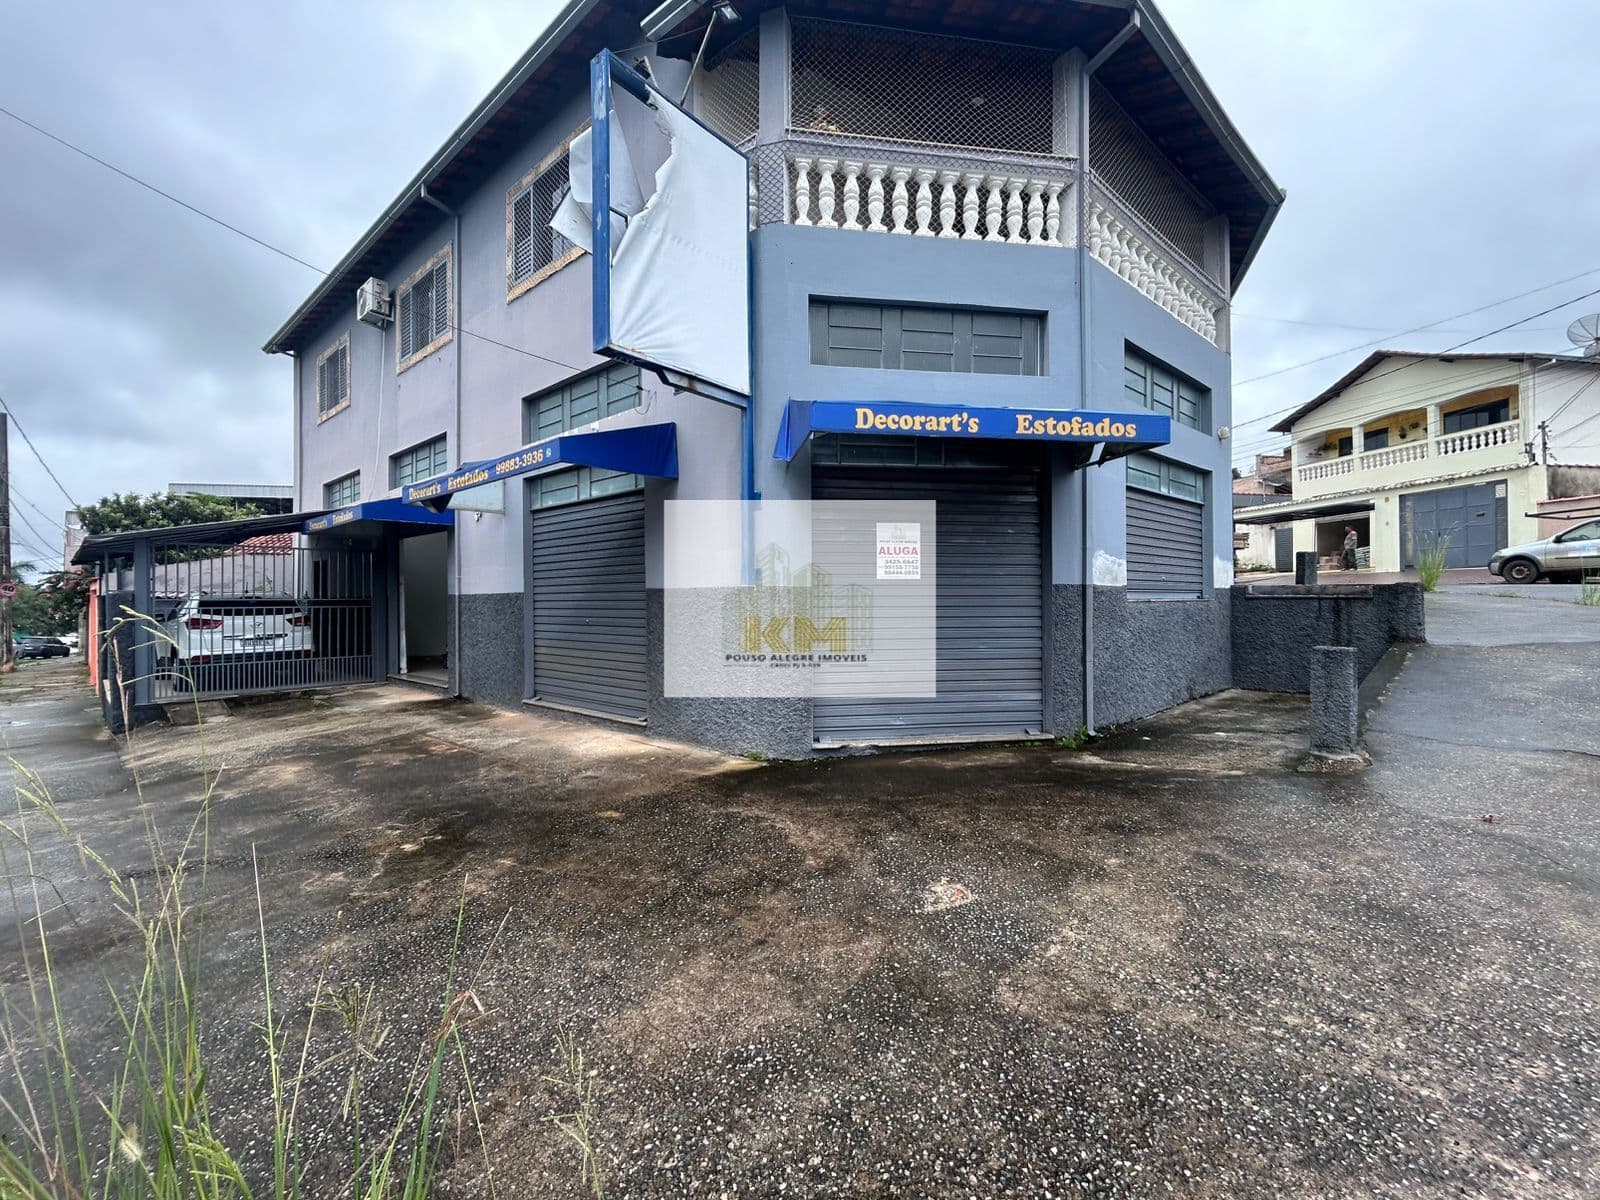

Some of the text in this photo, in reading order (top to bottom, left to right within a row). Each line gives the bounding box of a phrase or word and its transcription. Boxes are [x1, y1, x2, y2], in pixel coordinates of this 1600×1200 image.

[855, 408, 1137, 438] Decorart's Estofados
[447, 469, 489, 491] Estofados
[495, 449, 544, 475] 99883-3936
[878, 546, 919, 556] ALUGA
